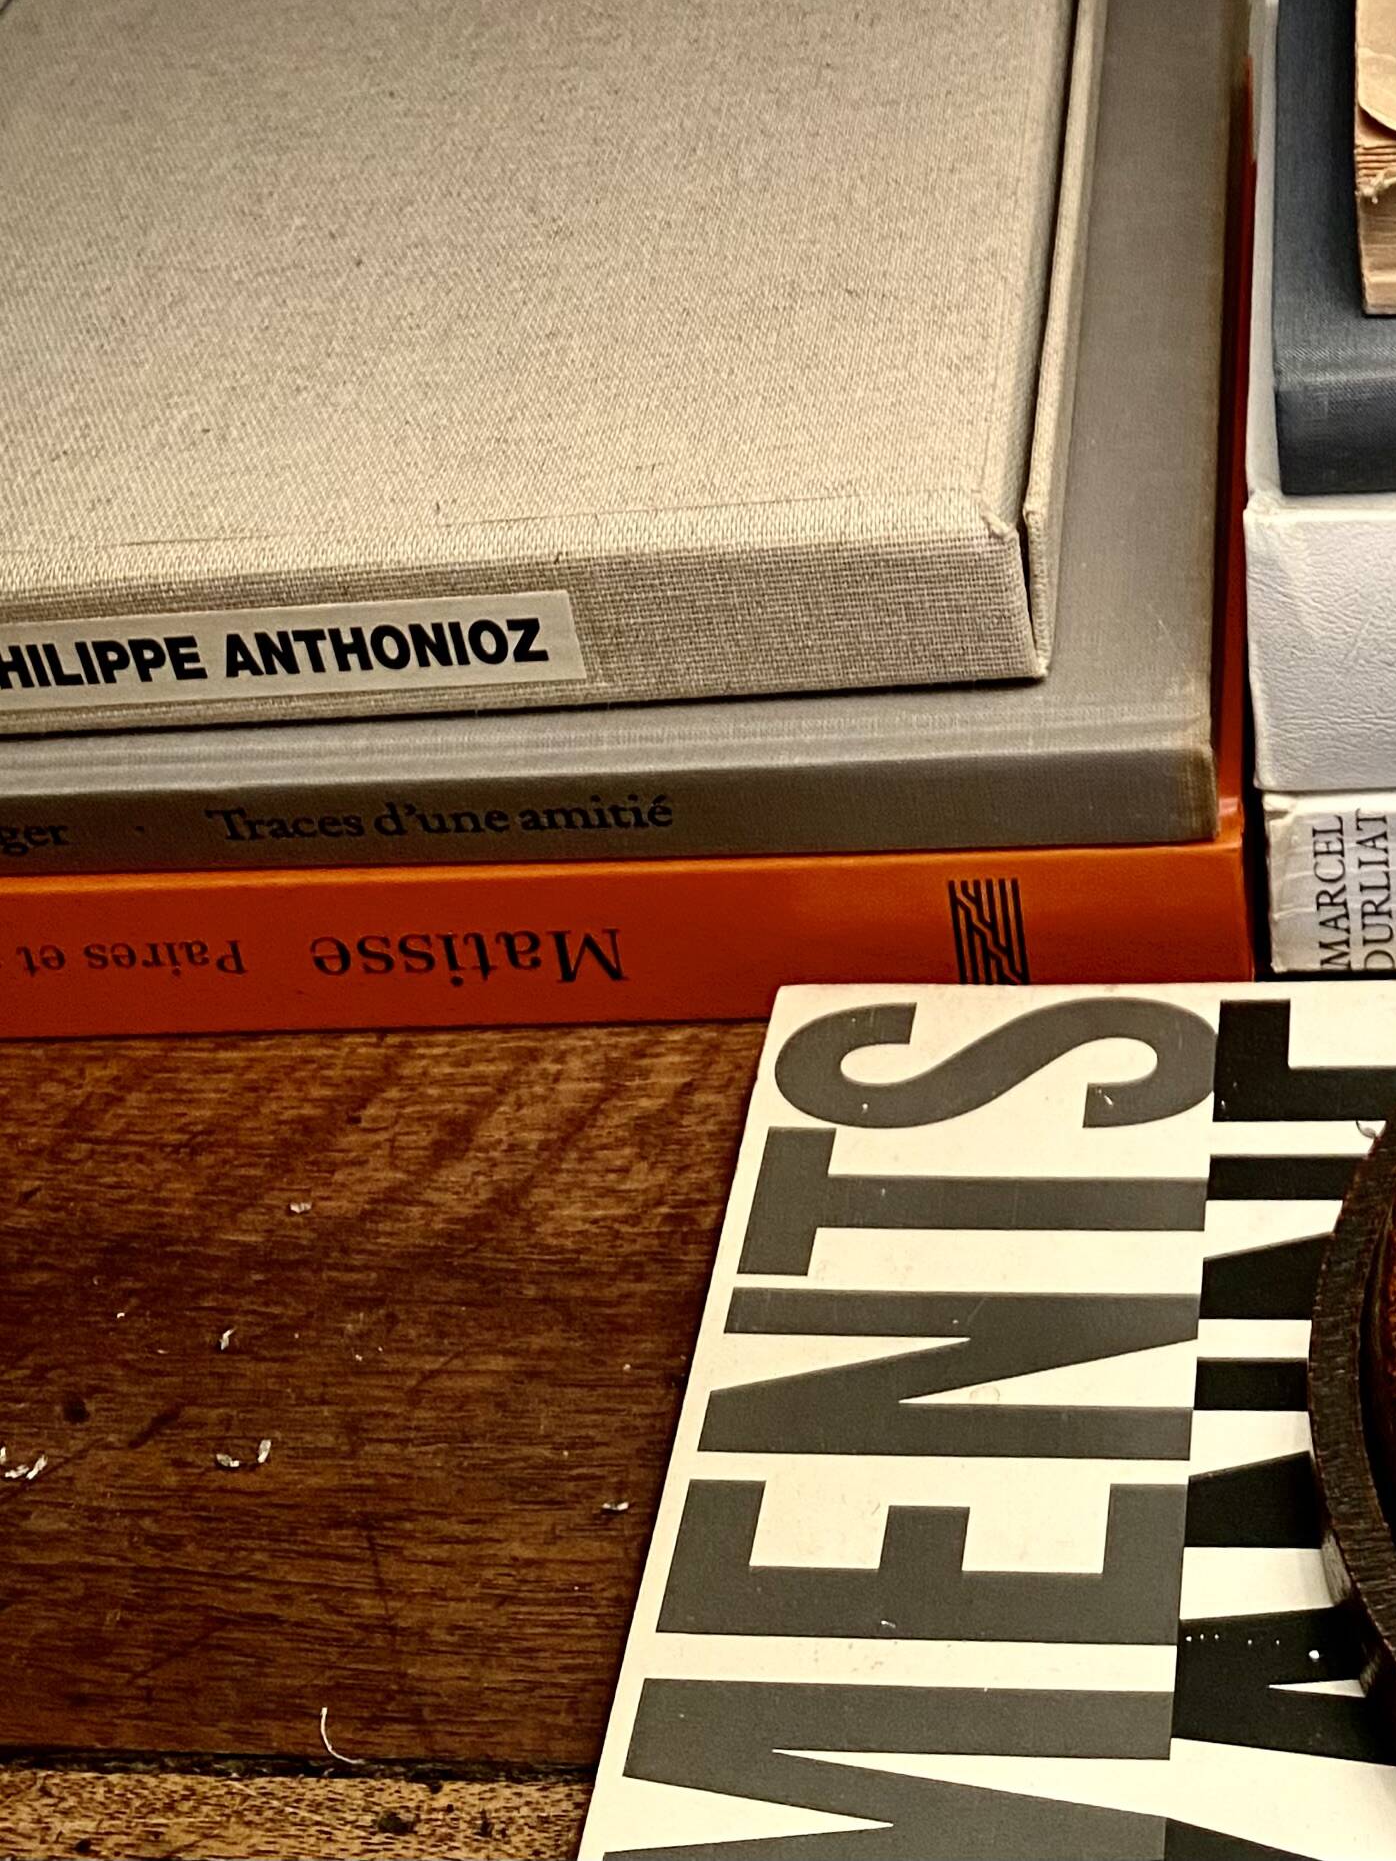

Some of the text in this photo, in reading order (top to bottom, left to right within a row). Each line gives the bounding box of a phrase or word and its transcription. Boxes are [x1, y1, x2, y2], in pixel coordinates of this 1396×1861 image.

[0, 618, 549, 689] HILIPPE ANTHONIOZ
[0, 794, 674, 857] ger Traces d'une amitié
[1312, 815, 1351, 970] MARCEL
[16, 926, 630, 987] Matisse Paires et
